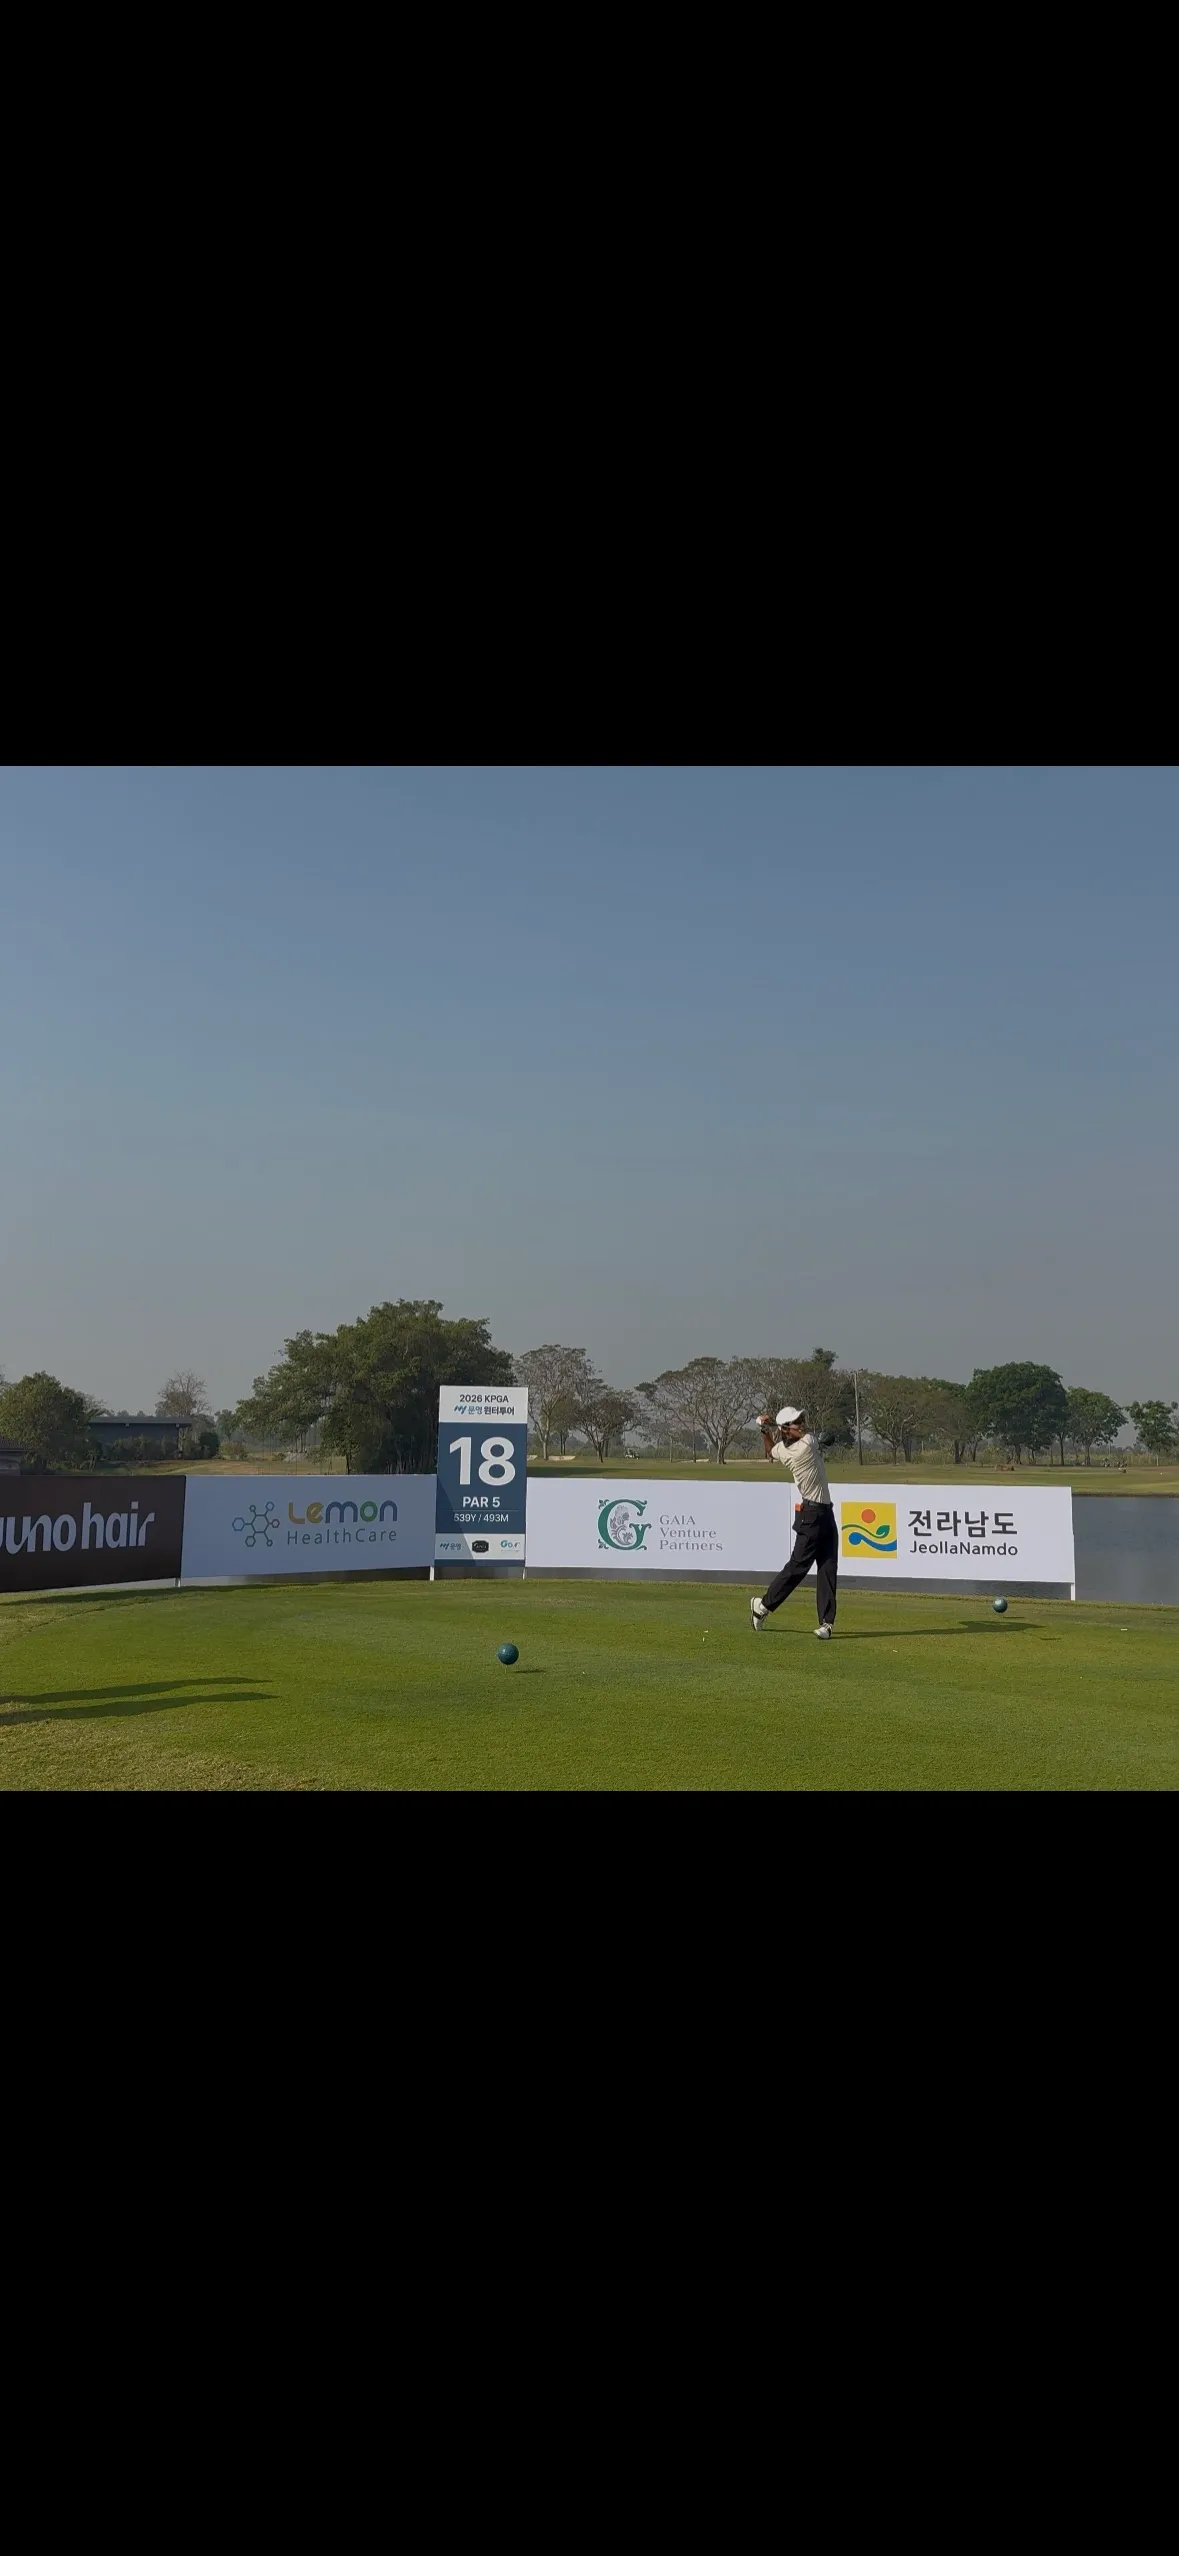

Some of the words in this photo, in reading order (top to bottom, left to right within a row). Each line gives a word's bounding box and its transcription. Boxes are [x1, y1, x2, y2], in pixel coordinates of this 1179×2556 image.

[459, 1394, 483, 1403] 2026
[484, 1394, 509, 1403] KPGA
[449, 1436, 516, 1487] 18
[462, 1496, 489, 1508] PAR
[492, 1496, 501, 1508] 5
[453, 1513, 477, 1522] 539Y
[483, 1513, 509, 1522] 493M
[659, 1514, 696, 1526] GAIA
[907, 1509, 1018, 1538] 전라남도
[81, 1501, 155, 1550] hair
[287, 1528, 397, 1545] HealthCare
[659, 1527, 717, 1539] Venture
[659, 1539, 724, 1552] Partners
[909, 1540, 1018, 1556] JeollaNamdo
